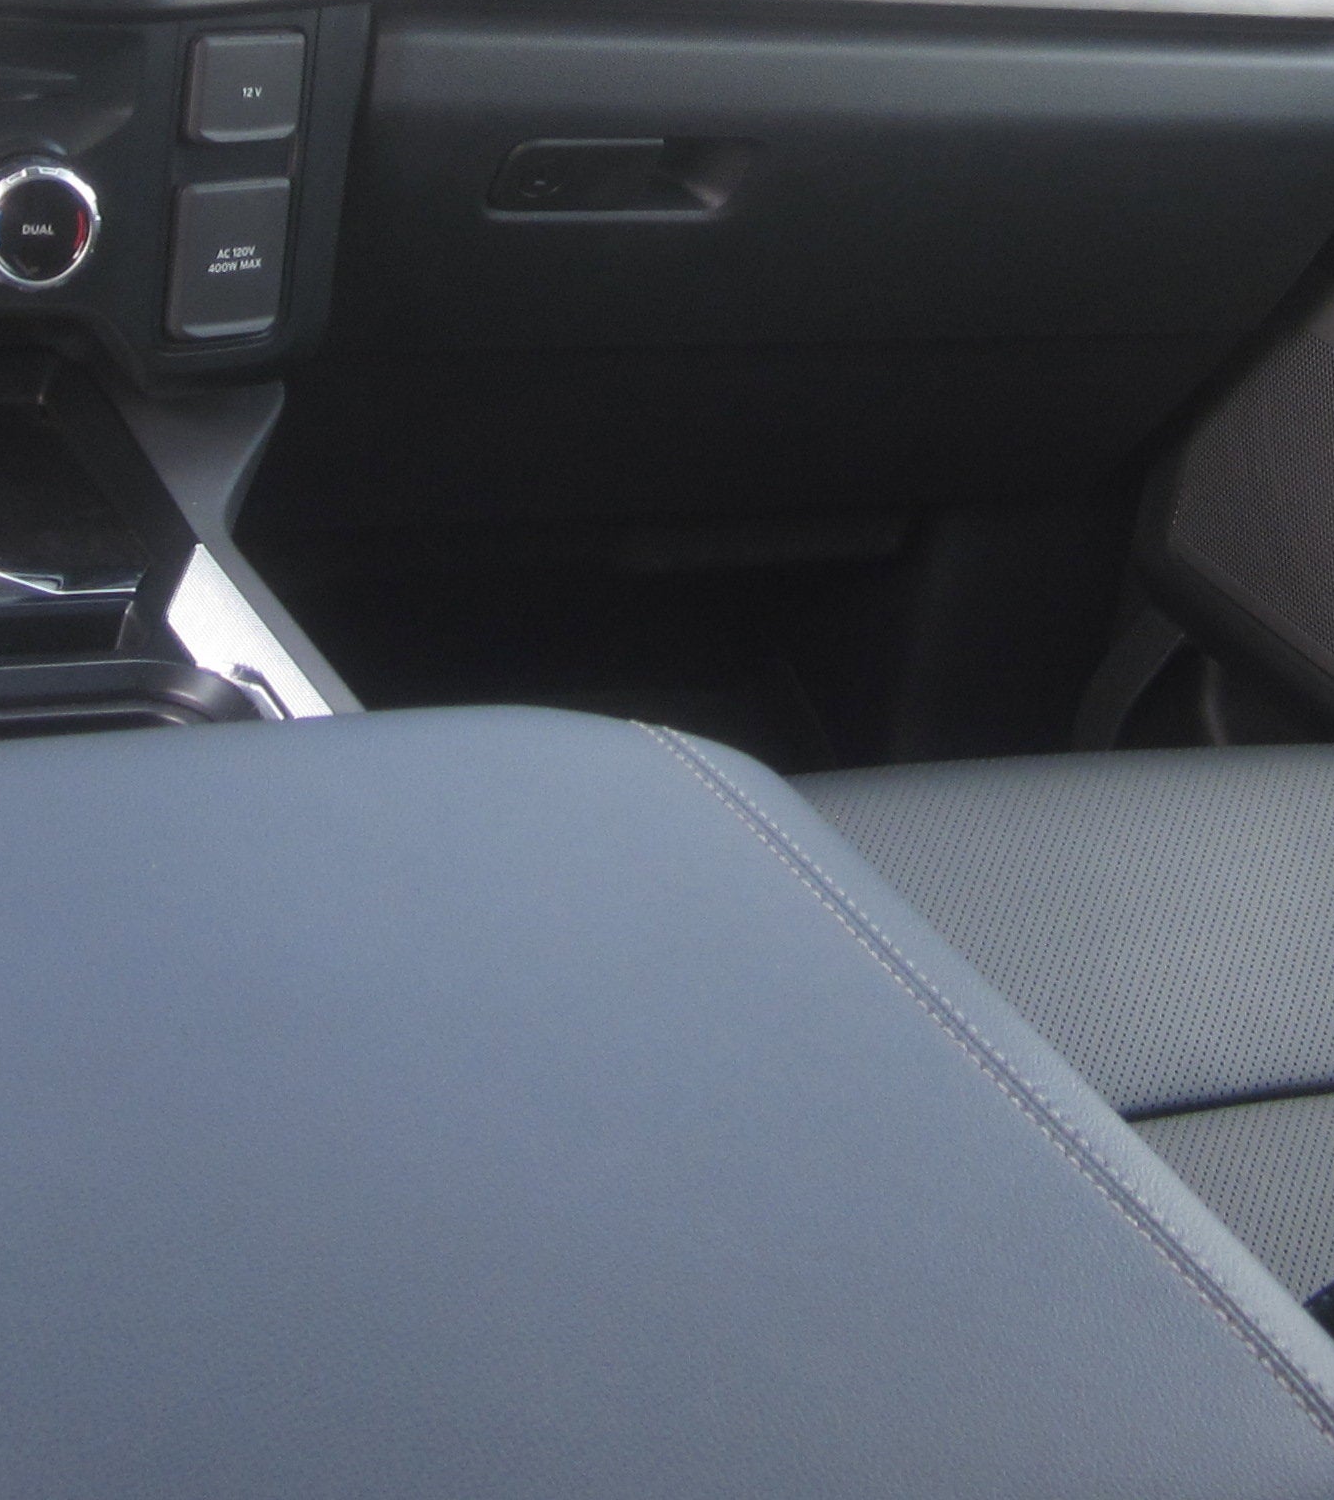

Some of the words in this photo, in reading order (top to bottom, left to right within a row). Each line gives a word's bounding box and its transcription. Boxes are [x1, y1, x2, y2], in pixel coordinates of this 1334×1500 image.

[22, 223, 55, 235] DUAL
[217, 248, 231, 260] AC
[232, 246, 256, 258] 120V
[208, 260, 238, 273] 400W
[239, 258, 262, 270] MAX
